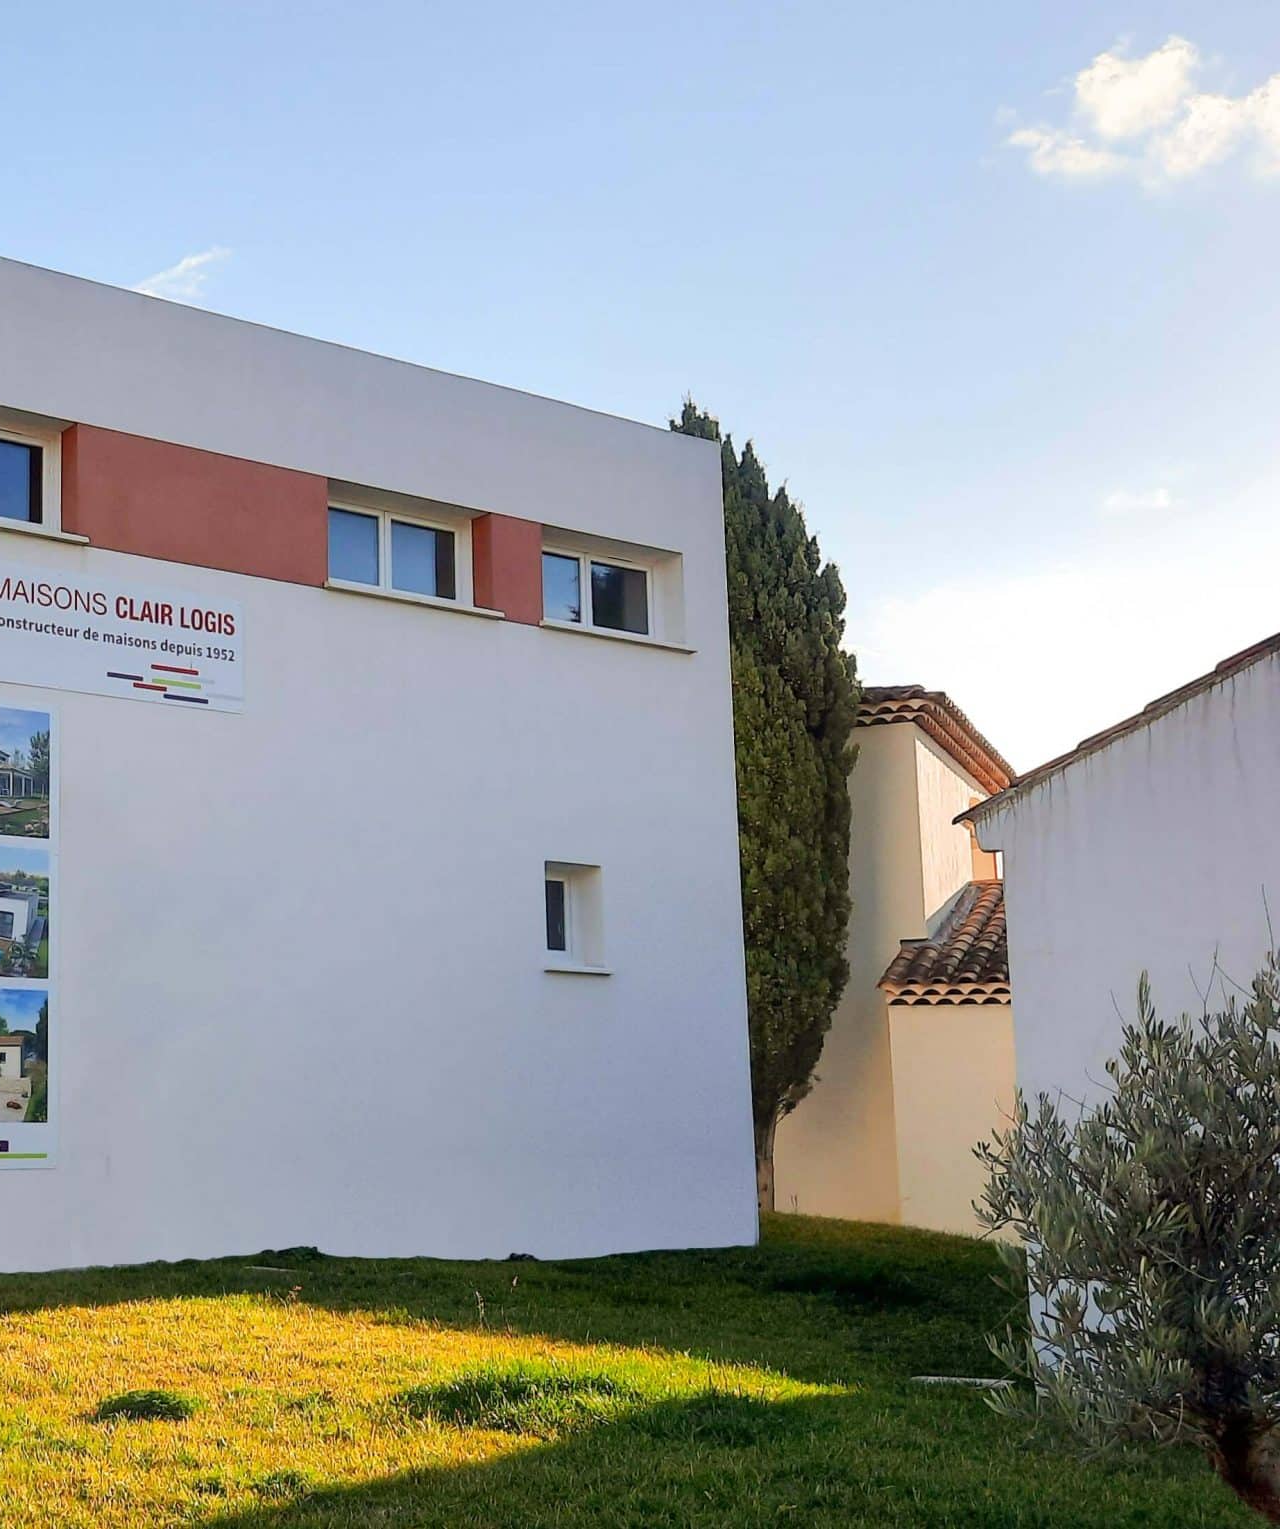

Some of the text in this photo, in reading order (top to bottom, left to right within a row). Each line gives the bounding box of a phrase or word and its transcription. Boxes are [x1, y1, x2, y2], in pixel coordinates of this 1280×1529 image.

[115, 596, 173, 626] CLAIR
[180, 606, 235, 636] LOGIS
[83, 627, 99, 642] de
[103, 632, 158, 650] maisons
[160, 639, 203, 657] depuis
[206, 646, 236, 662] 1952
